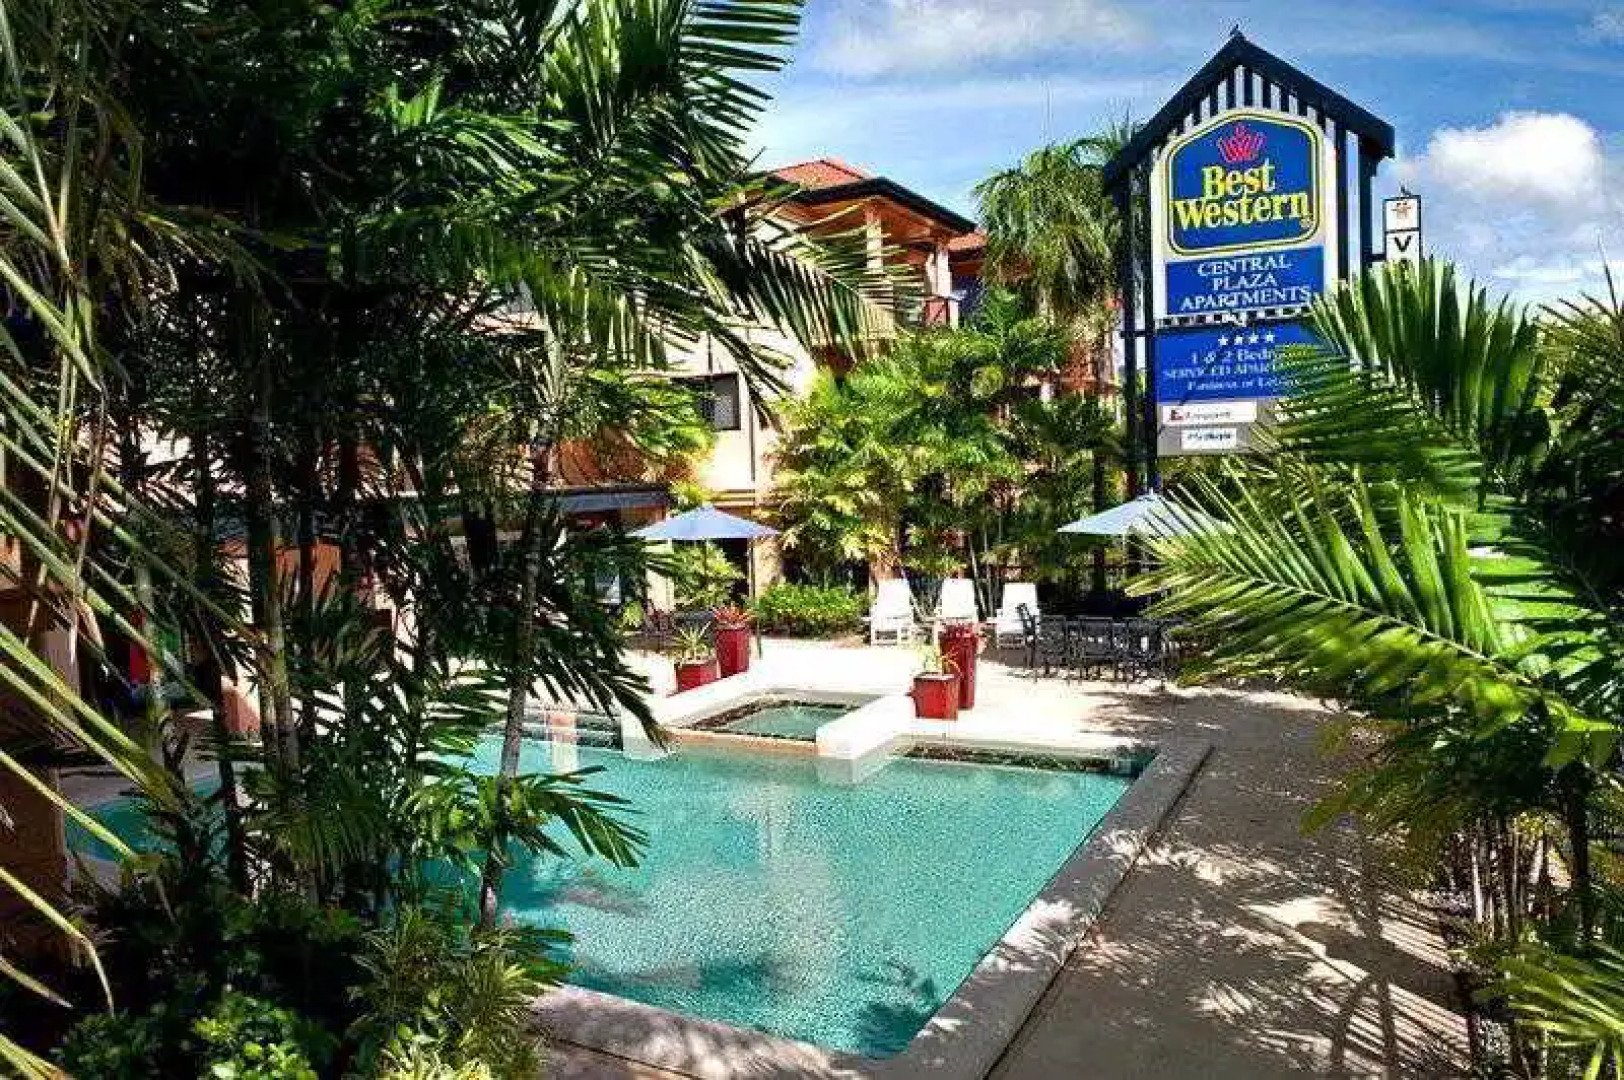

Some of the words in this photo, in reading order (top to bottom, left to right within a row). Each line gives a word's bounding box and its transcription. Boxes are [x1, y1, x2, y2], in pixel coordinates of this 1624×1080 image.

[1202, 158, 1276, 200] Best
[1170, 192, 1308, 230] Western
[1198, 254, 1293, 276] CENTRAL
[1213, 271, 1277, 291] PLAZA
[1180, 285, 1311, 311] APARTMENTS
